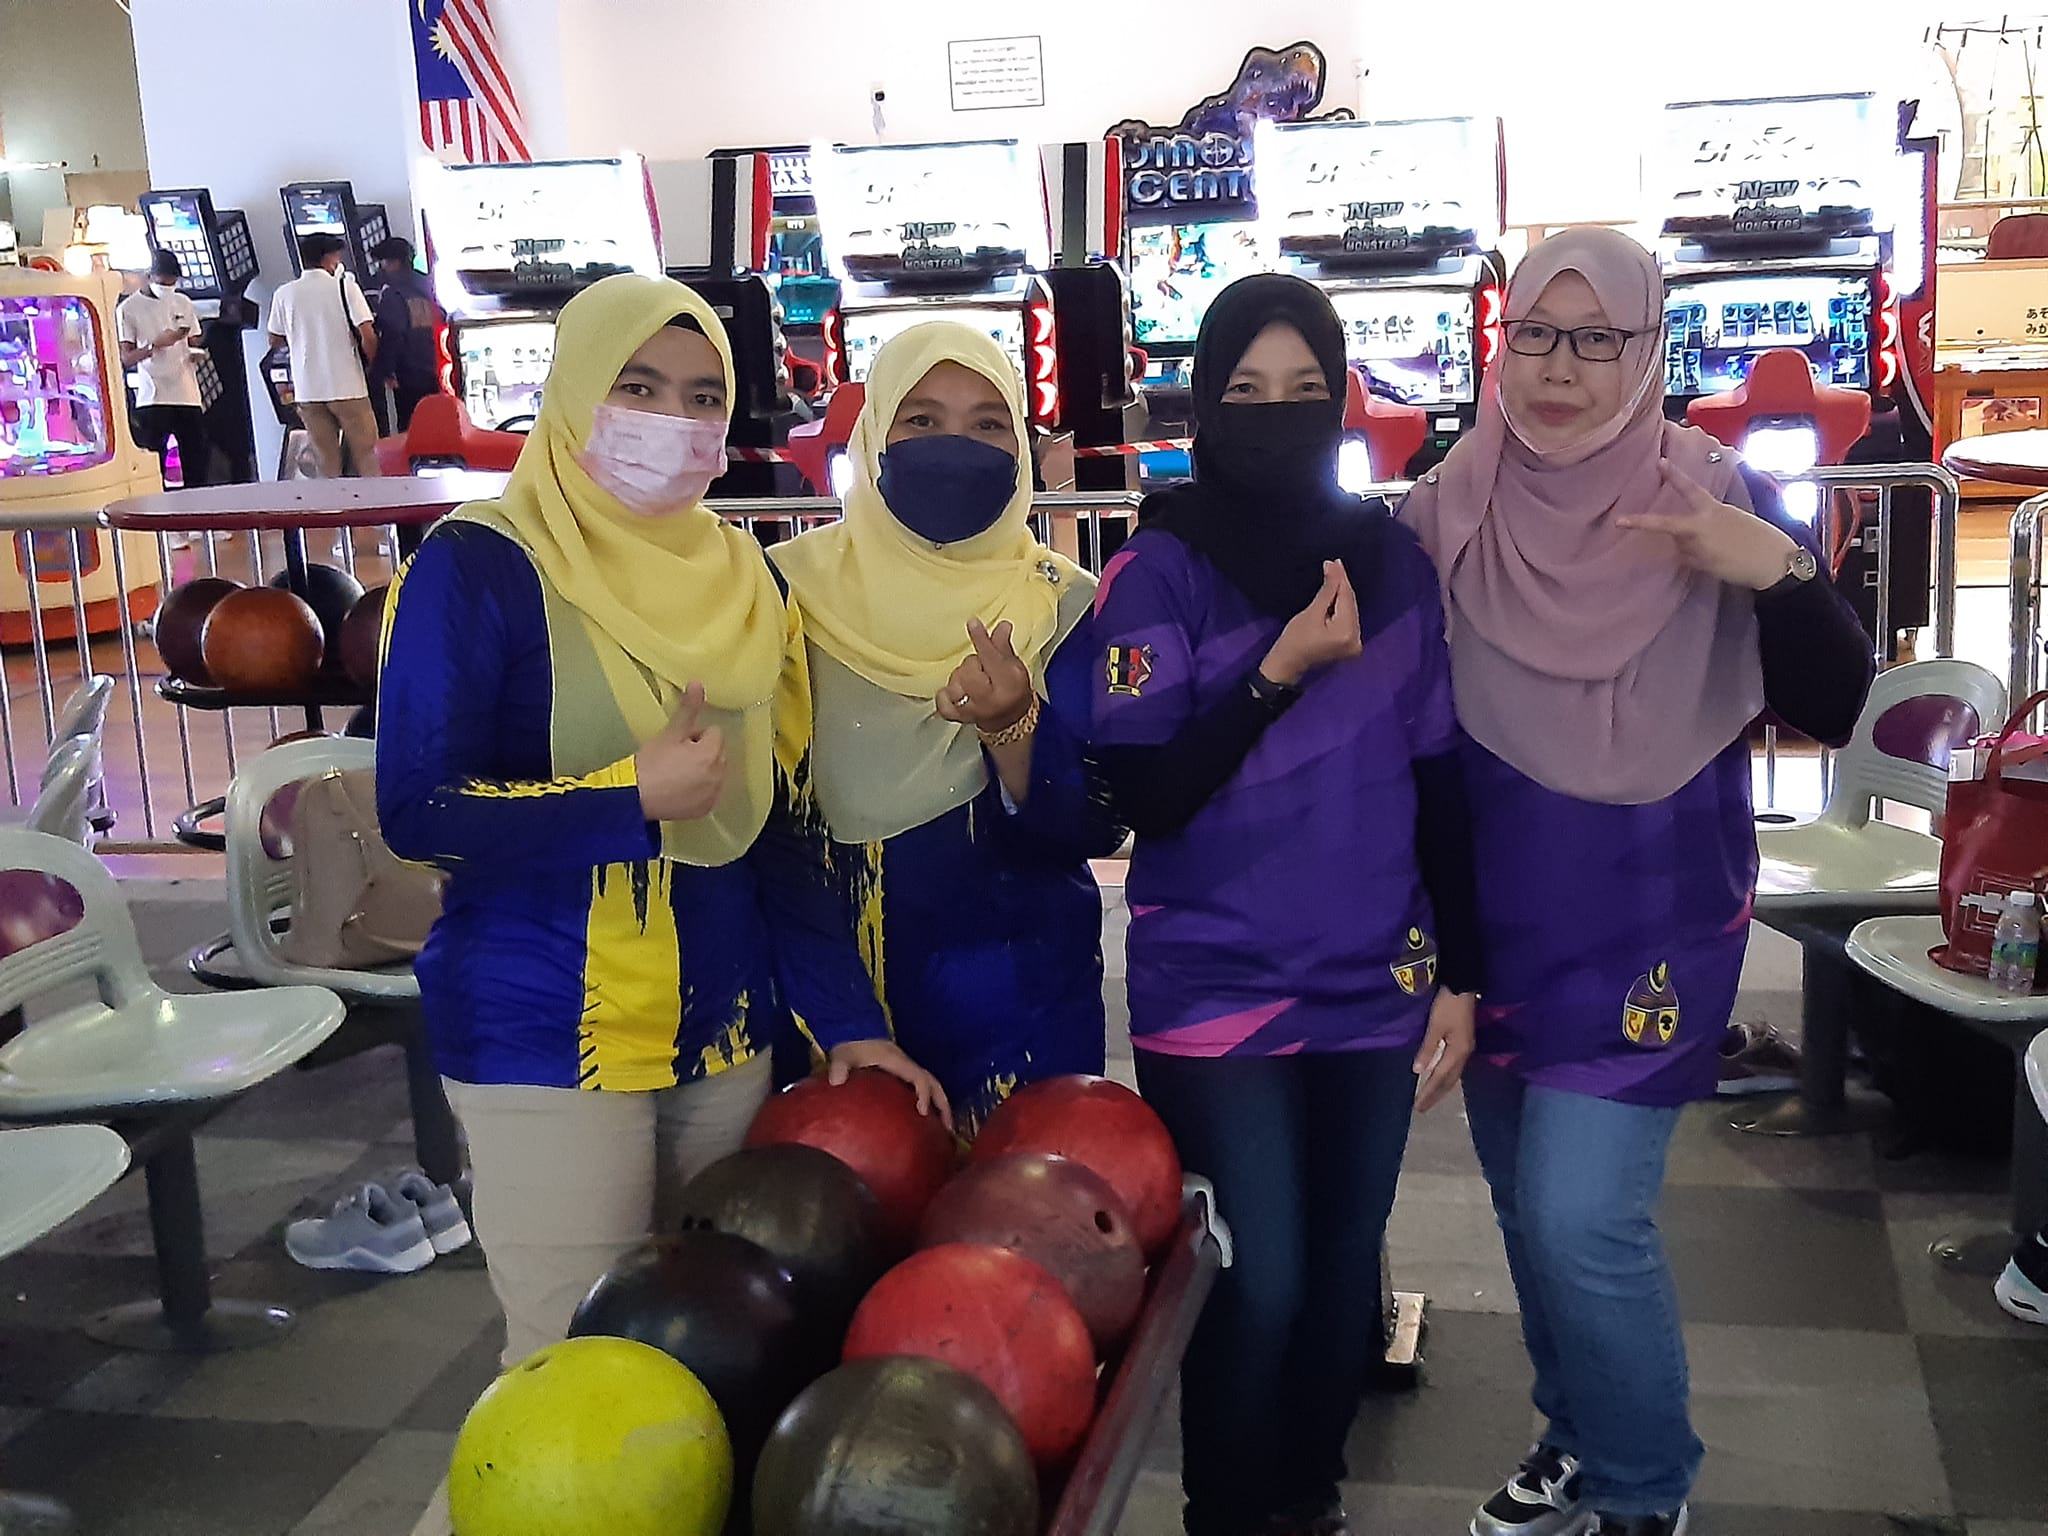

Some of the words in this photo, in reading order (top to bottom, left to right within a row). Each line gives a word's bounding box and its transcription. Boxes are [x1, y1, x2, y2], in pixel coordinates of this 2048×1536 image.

[1129, 167, 1256, 203] CENT
[1739, 180, 1800, 200] New
[1348, 201, 1404, 220] New
[904, 222, 957, 240] New
[1734, 219, 1800, 232] MONSTERS
